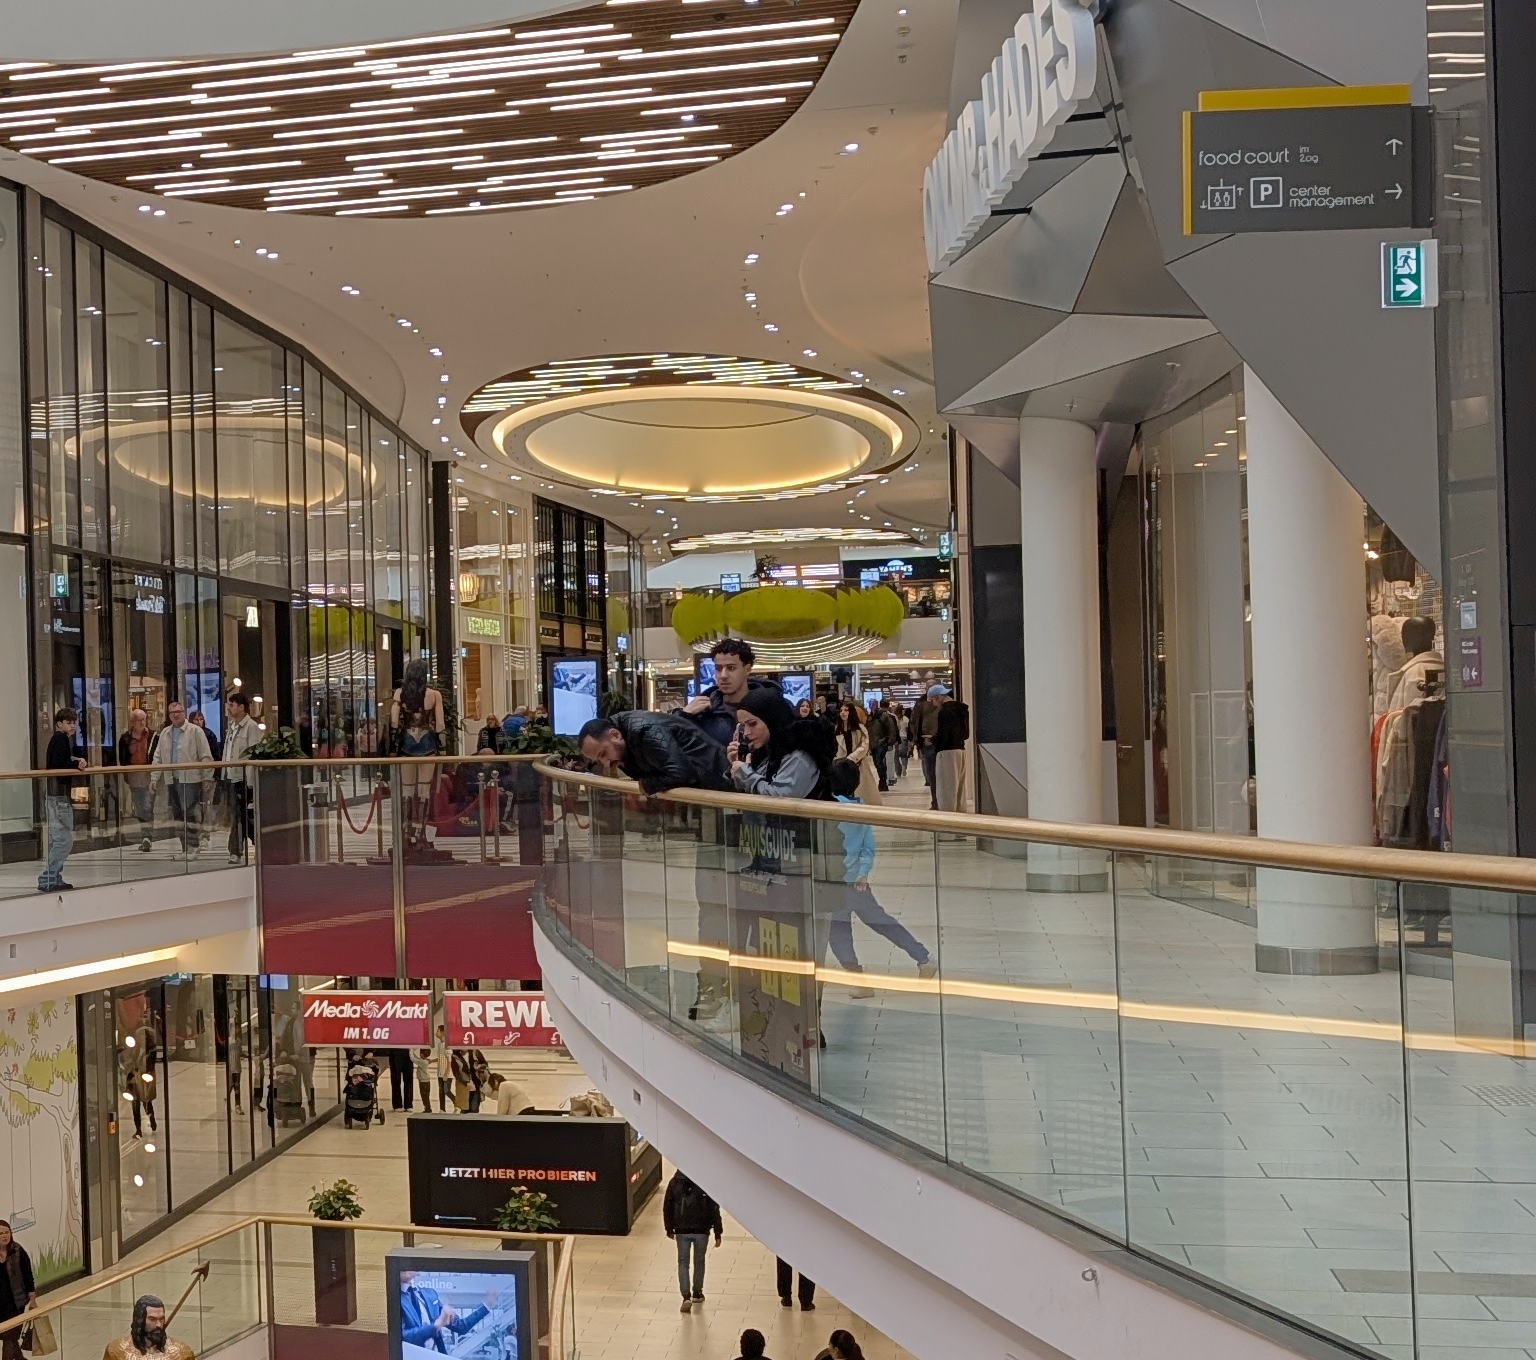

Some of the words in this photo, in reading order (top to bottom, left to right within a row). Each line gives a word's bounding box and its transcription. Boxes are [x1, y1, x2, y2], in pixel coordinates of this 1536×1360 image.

[1199, 150, 1242, 166] food
[1244, 148, 1290, 165] court
[1260, 184, 1272, 201] P
[1289, 186, 1332, 197] center
[1289, 193, 1374, 208] management
[304, 1000, 362, 1018] Media
[376, 1000, 428, 1019] Markt
[343, 1027, 361, 1039] IM
[441, 1167, 480, 1178] JETZT
